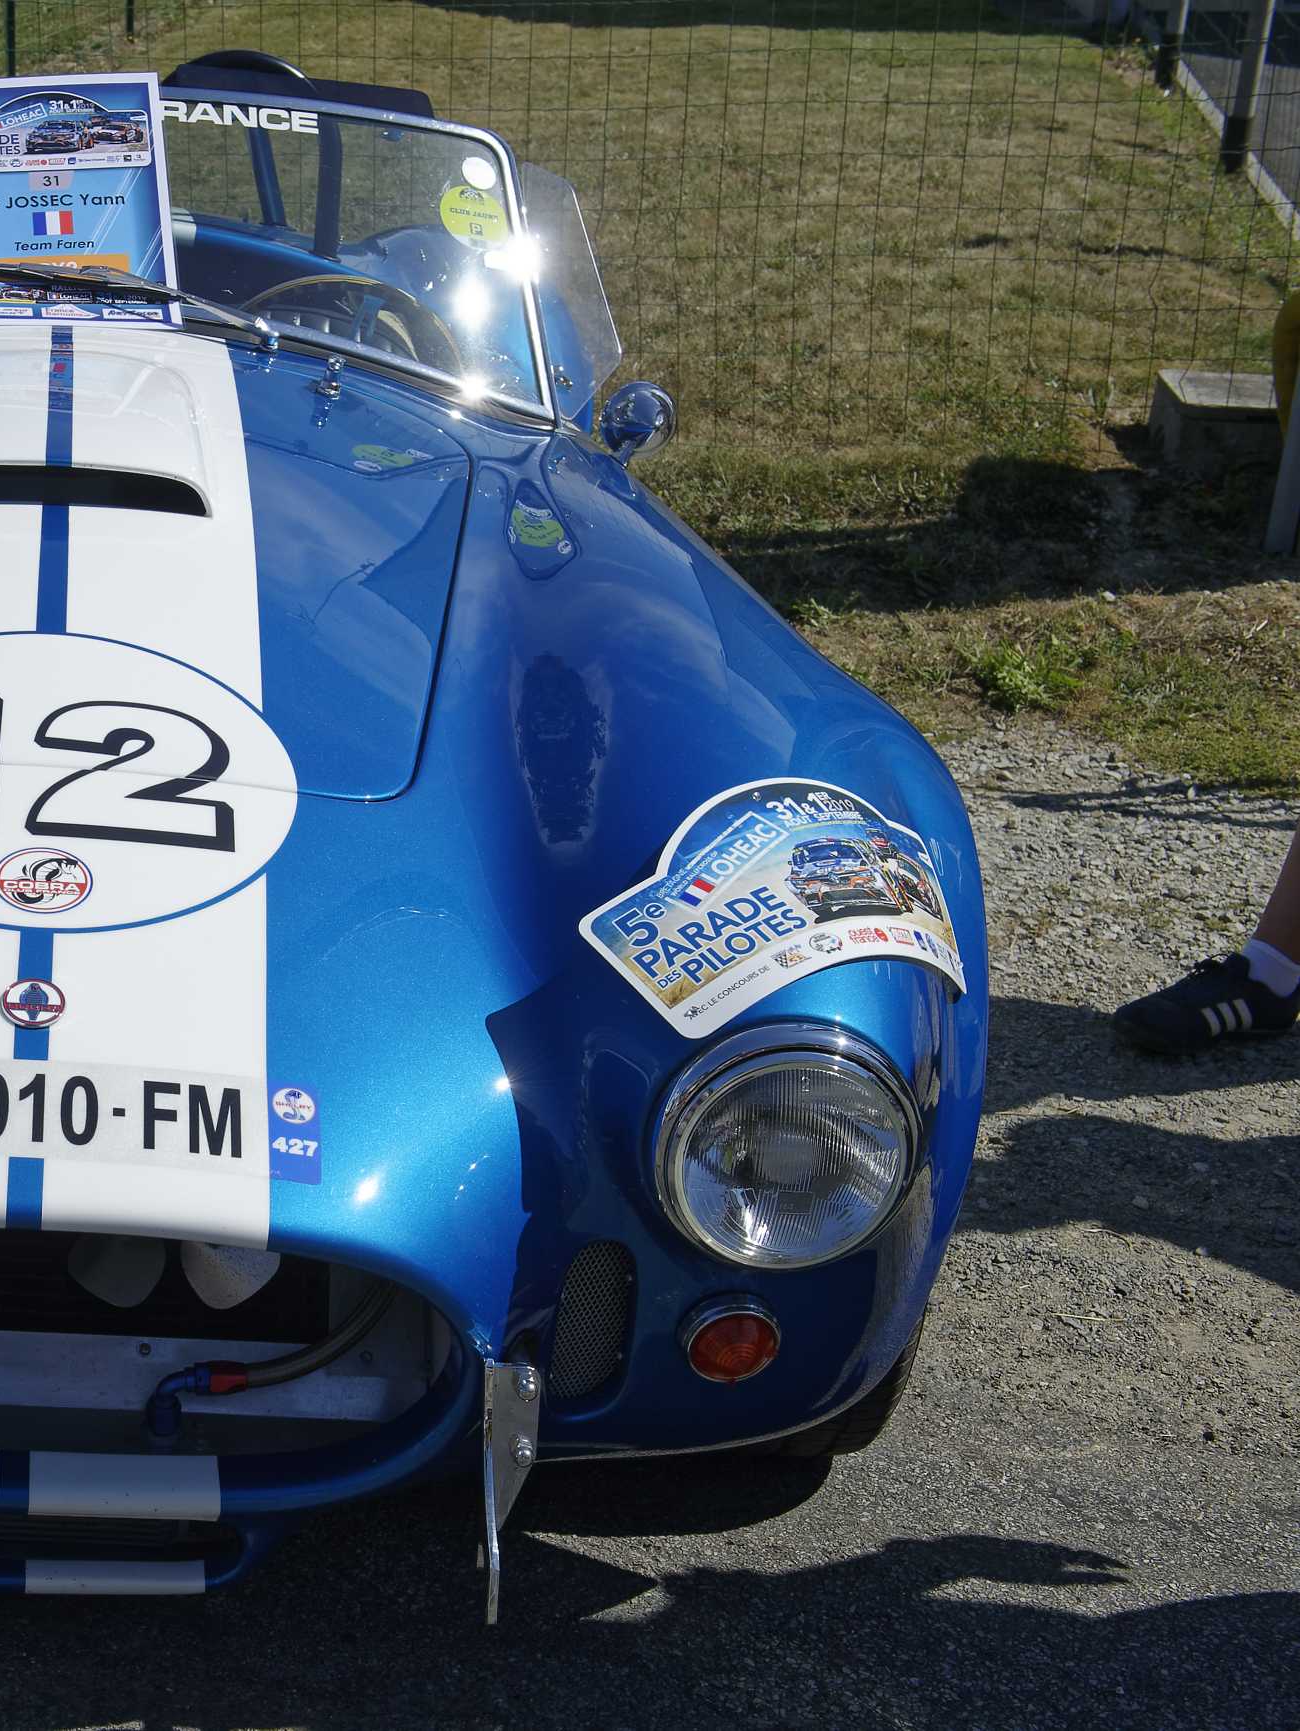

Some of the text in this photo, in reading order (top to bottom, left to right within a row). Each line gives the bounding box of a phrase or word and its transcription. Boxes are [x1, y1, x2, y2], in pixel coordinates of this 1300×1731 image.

[1, 109, 43, 126] LOHEAC
[159, 100, 319, 134] RANCE
[43, 176, 60, 187] 31
[6, 194, 74, 208] JOSSEC
[79, 194, 126, 206] Yann
[14, 239, 95, 252] Team Faren
[824, 799, 856, 813] 2019
[814, 811, 863, 822] SEPTEMBRE
[701, 823, 777, 883] LOHEAC
[3, 880, 80, 891] COBRA
[614, 903, 667, 947] 5e
[632, 886, 787, 978] PARADE
[680, 908, 807, 984] PILOTES
[657, 969, 682, 989] DES
[707, 997, 718, 1007] LE
[717, 971, 759, 1000] CONCOURS
[758, 965, 770, 974] DE
[272, 1136, 318, 1157] 427
